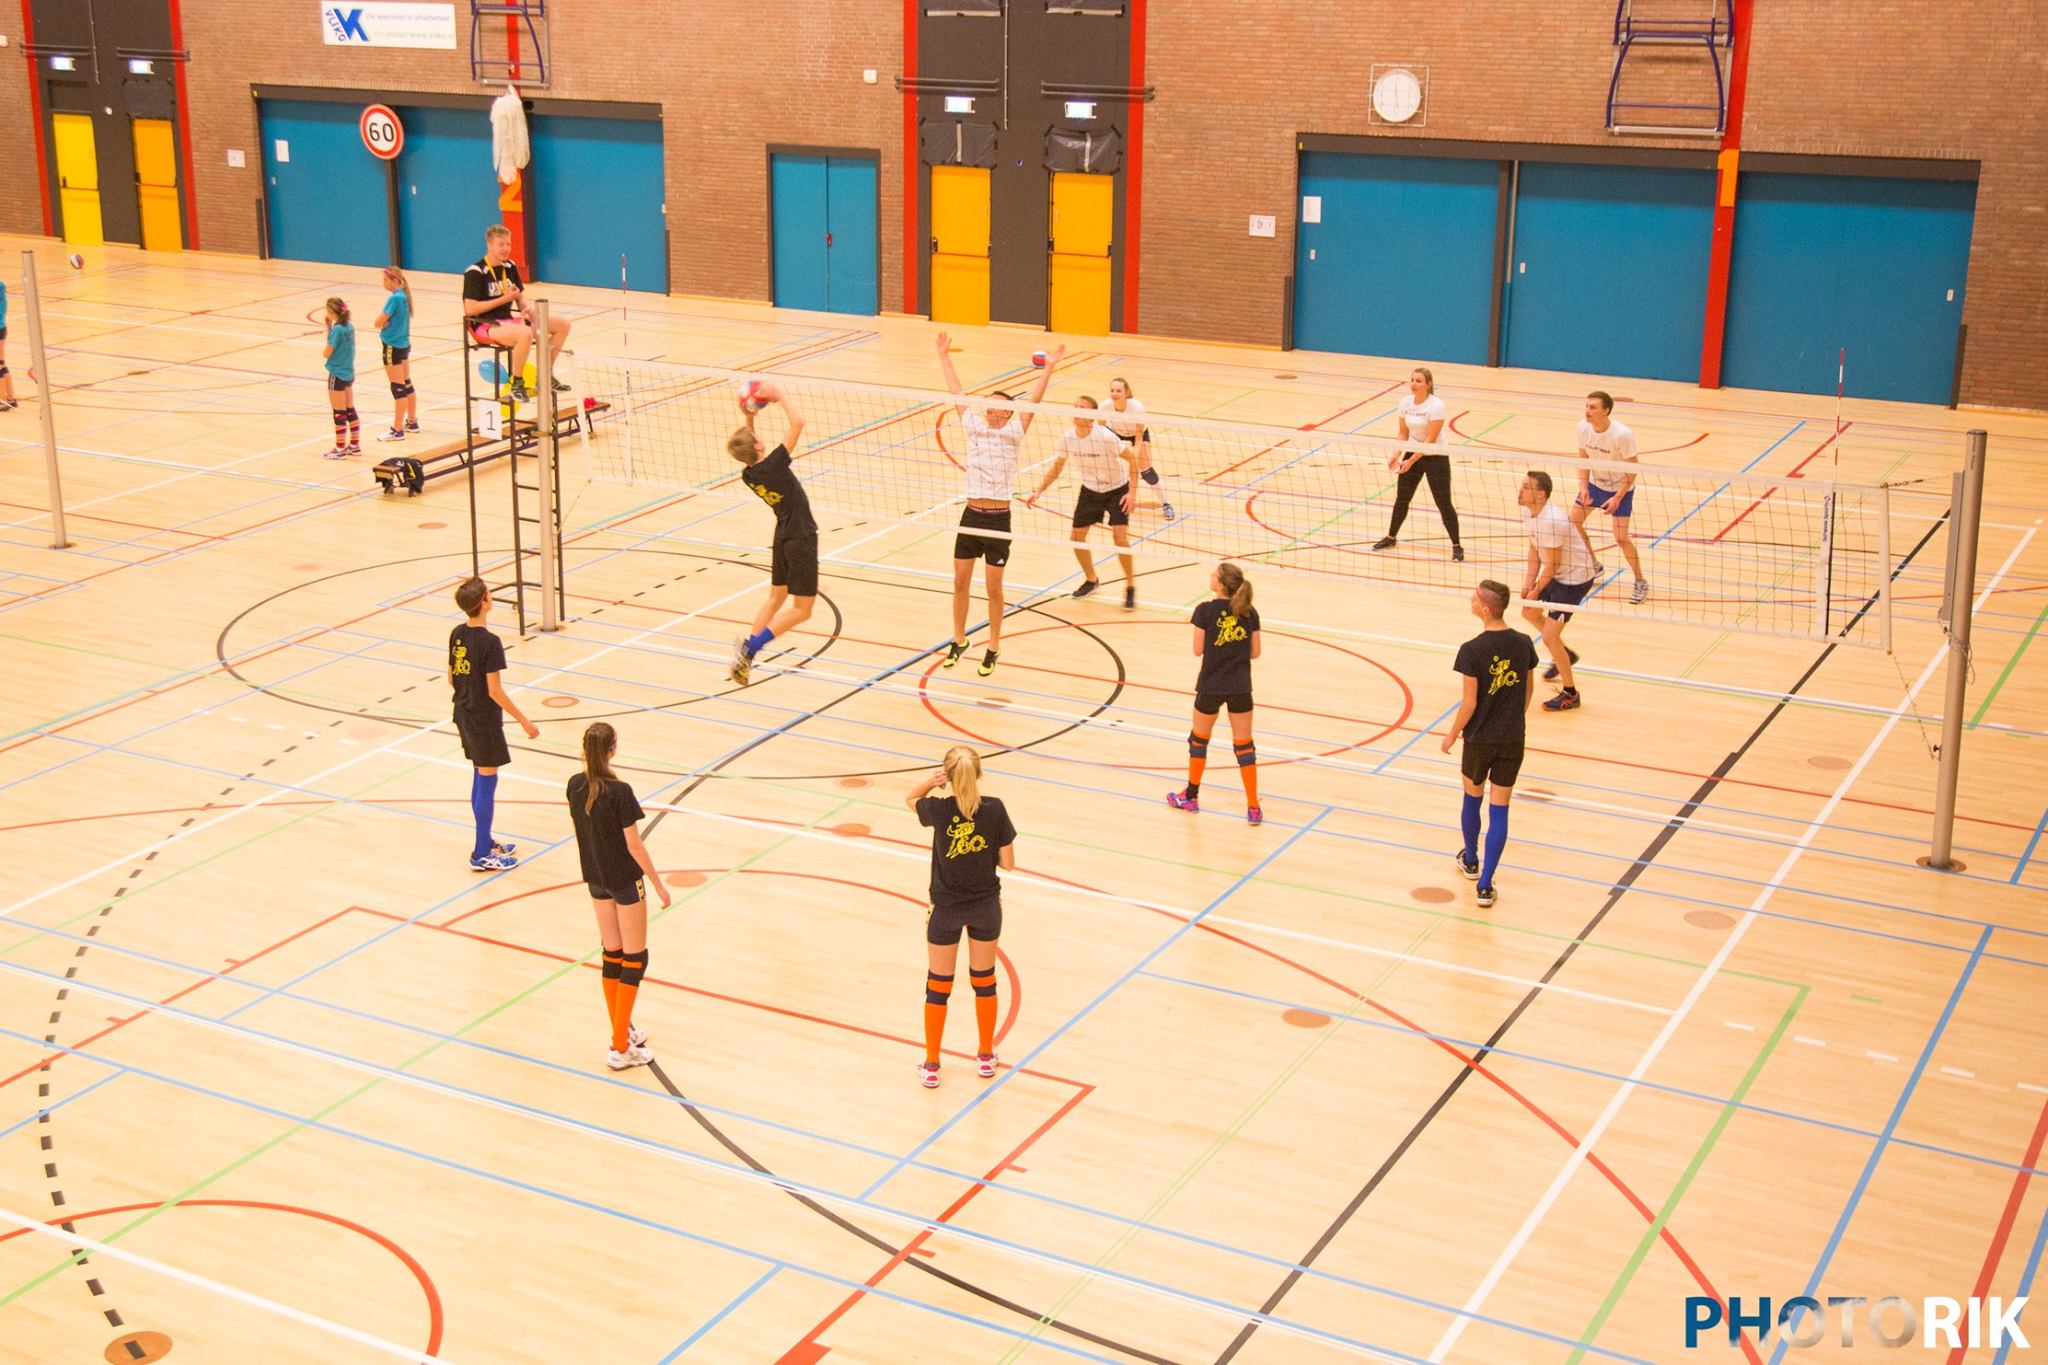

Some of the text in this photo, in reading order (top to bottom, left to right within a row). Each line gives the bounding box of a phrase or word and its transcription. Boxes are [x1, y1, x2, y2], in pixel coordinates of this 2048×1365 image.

[325, 9, 347, 42] VLIKO
[369, 122, 394, 142] 60
[1717, 149, 1739, 207] 1
[486, 410, 496, 431] 1
